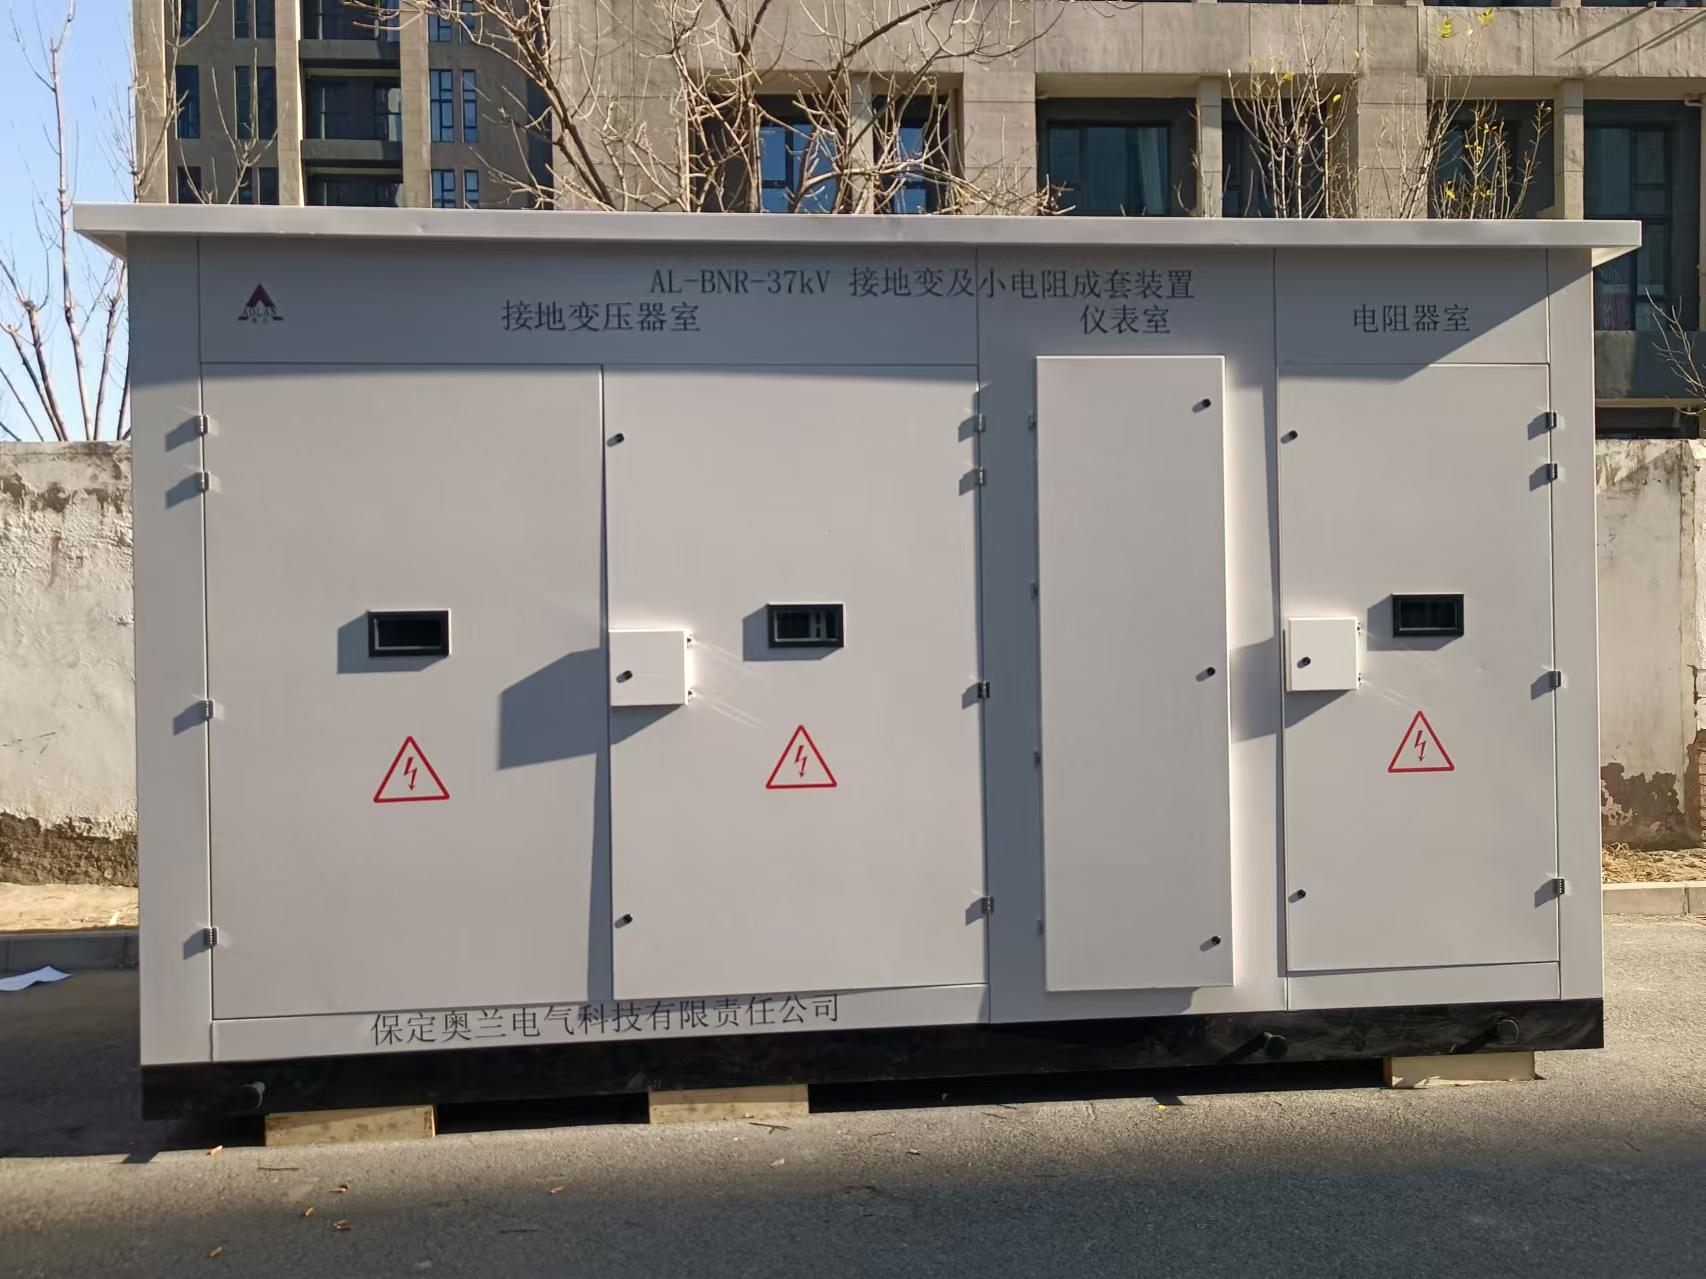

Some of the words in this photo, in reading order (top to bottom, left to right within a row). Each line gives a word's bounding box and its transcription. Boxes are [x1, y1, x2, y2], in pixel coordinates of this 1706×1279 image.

[651, 268, 829, 295] AL-BNR-37kV
[849, 266, 1195, 299] 接地变及小电阻成套装置
[502, 300, 702, 333] 接地变压器室
[1080, 305, 1171, 335] 仪表室
[1353, 304, 1471, 333] 电阻器室
[371, 993, 840, 1046] 保定奥兰电气科技有限责任公司
